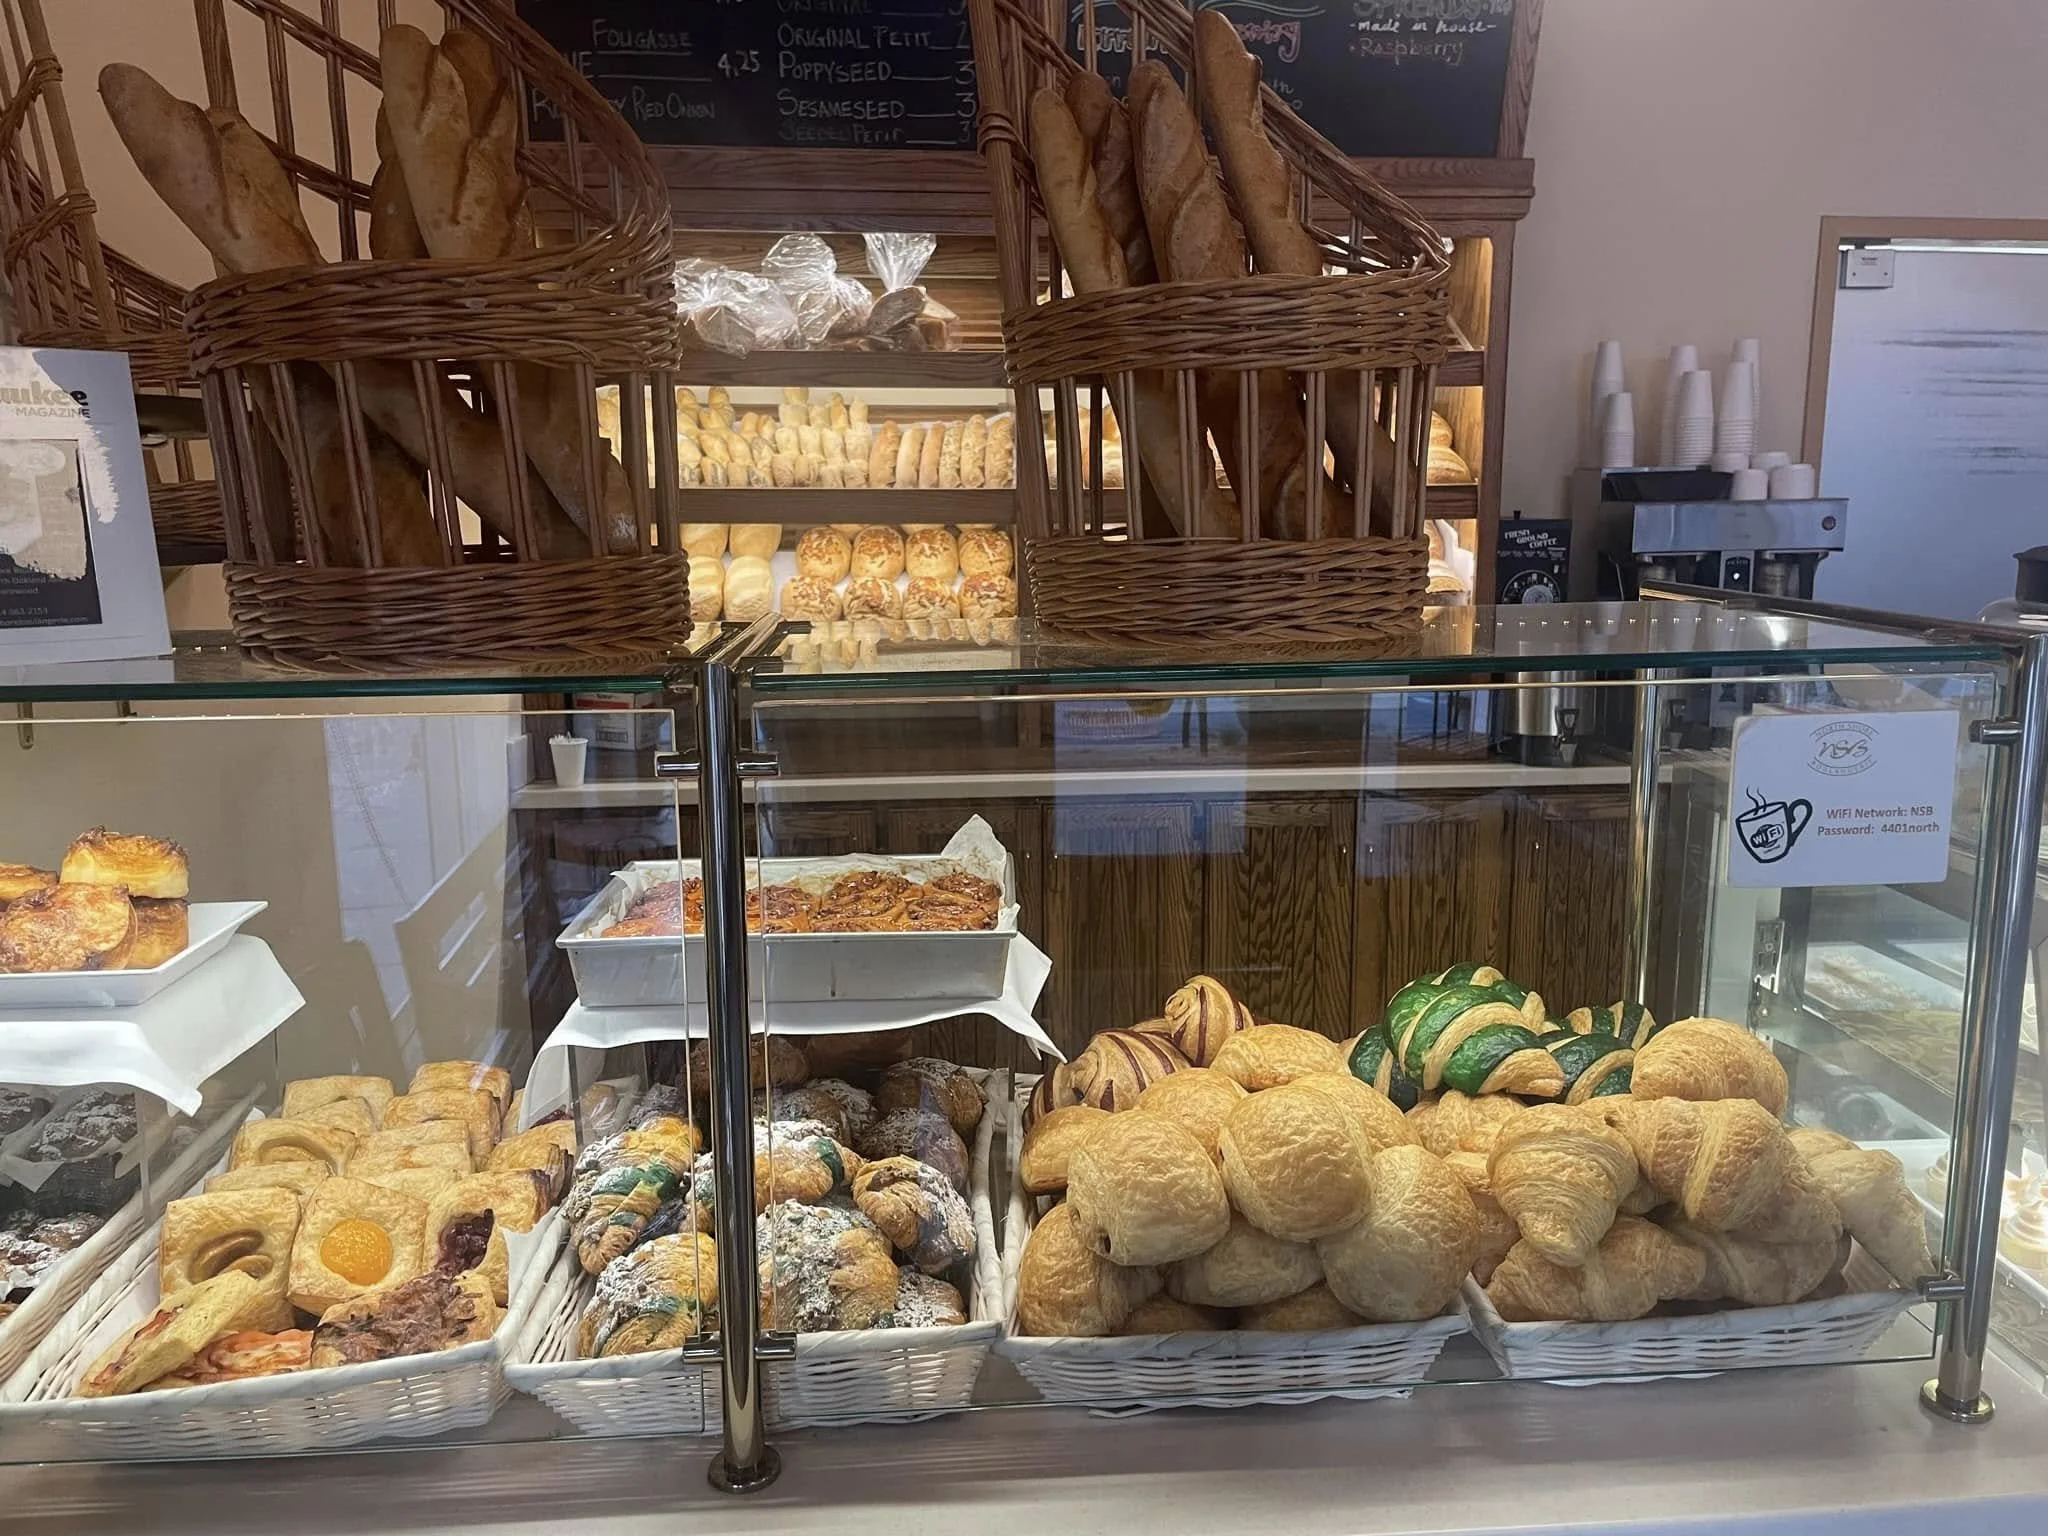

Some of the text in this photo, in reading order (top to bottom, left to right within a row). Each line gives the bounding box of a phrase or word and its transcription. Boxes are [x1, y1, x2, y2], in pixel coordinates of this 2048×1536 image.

[1411, 21, 1427, 31] in
[777, 23, 869, 48] ORIGINAL
[16, 407, 91, 418] MAGAZINE
[1529, 538, 1557, 549] COFFEE
[1855, 807, 1907, 818] Network:
[1911, 806, 1933, 816] NSB
[1818, 822, 1939, 836] Password: 4401north
